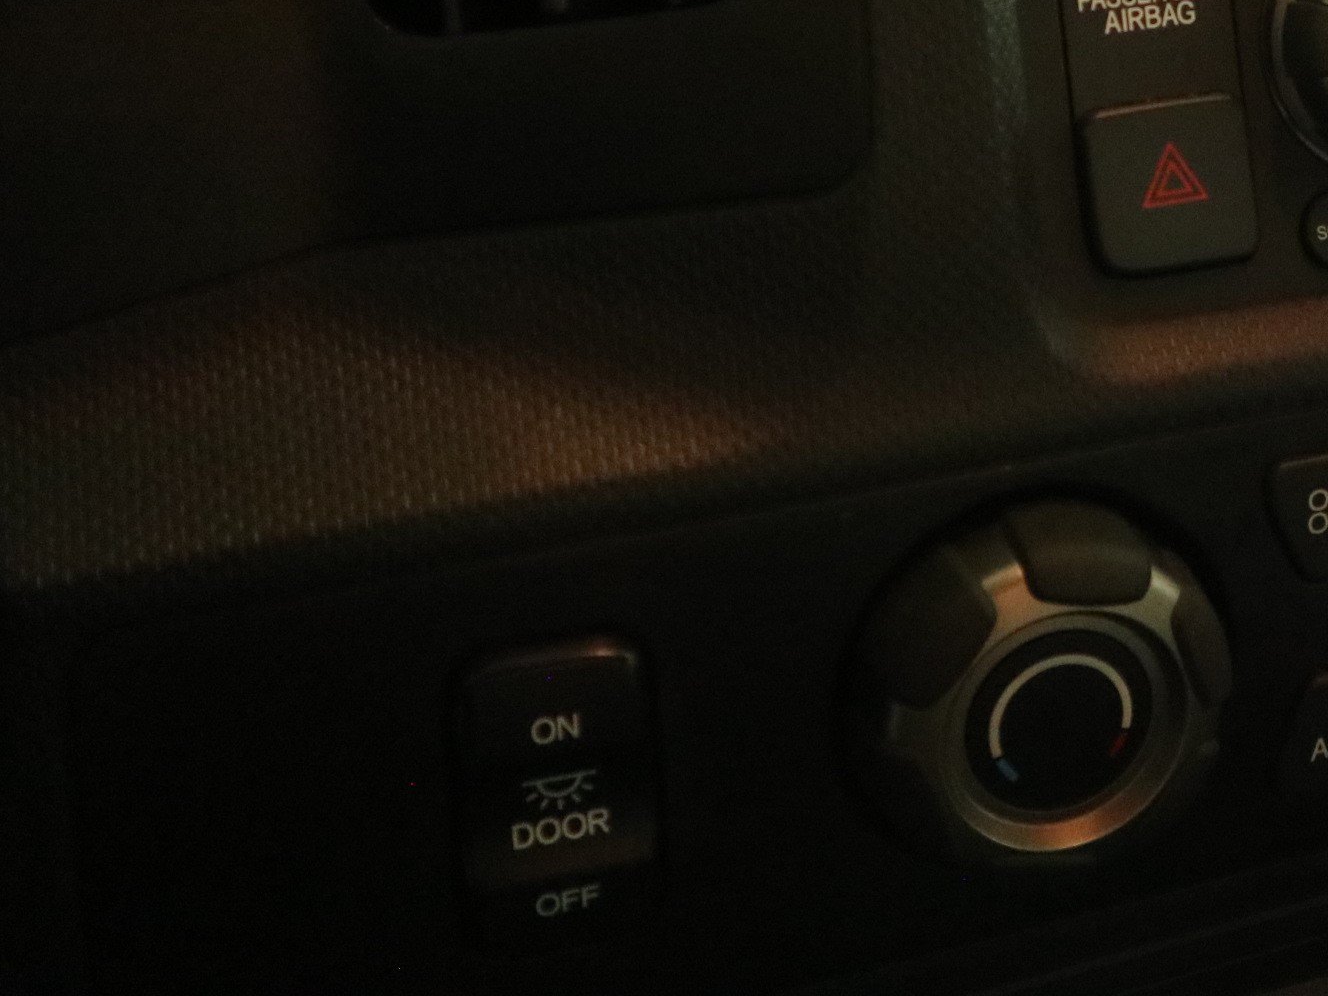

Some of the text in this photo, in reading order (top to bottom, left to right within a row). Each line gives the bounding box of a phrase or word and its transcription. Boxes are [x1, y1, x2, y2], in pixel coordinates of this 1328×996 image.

[1103, 0, 1197, 35] AIRBAG
[530, 712, 582, 745] ON
[511, 808, 612, 850] DOOR
[535, 882, 600, 918] OFF
